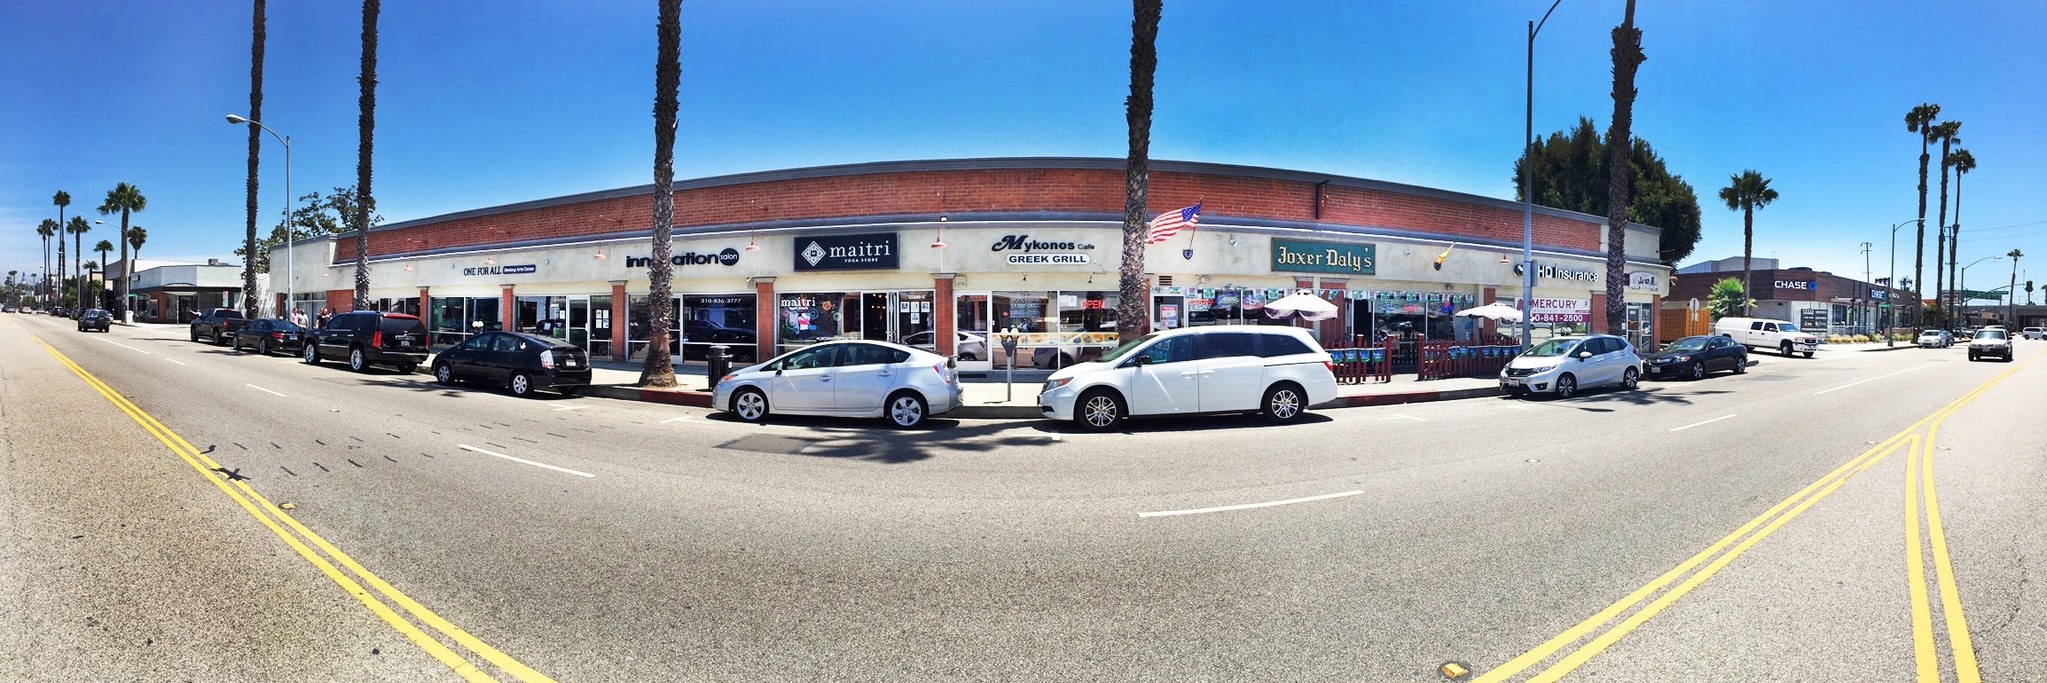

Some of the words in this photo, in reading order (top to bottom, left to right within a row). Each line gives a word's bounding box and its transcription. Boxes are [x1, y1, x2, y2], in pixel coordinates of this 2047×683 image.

[829, 240, 891, 258] maitri
[991, 235, 1075, 252] Mykonos
[626, 252, 720, 268] innation
[720, 253, 738, 261] salon
[1008, 255, 1049, 263] GREEK
[1052, 255, 1087, 263] GRILL
[1277, 246, 1323, 265] Joxer
[1325, 247, 1372, 272] Daly's
[463, 267, 477, 277] ONE
[477, 266, 489, 276] FOR
[490, 265, 502, 275] ALL
[1537, 265, 1553, 278] HD
[1555, 266, 1599, 282] Insurance
[1774, 280, 1808, 290] CHASE
[780, 296, 816, 307] maitri
[1081, 299, 1105, 310] OPEN
[1531, 299, 1577, 309] MERCURY
[1535, 314, 1583, 322] 0-841-2500
